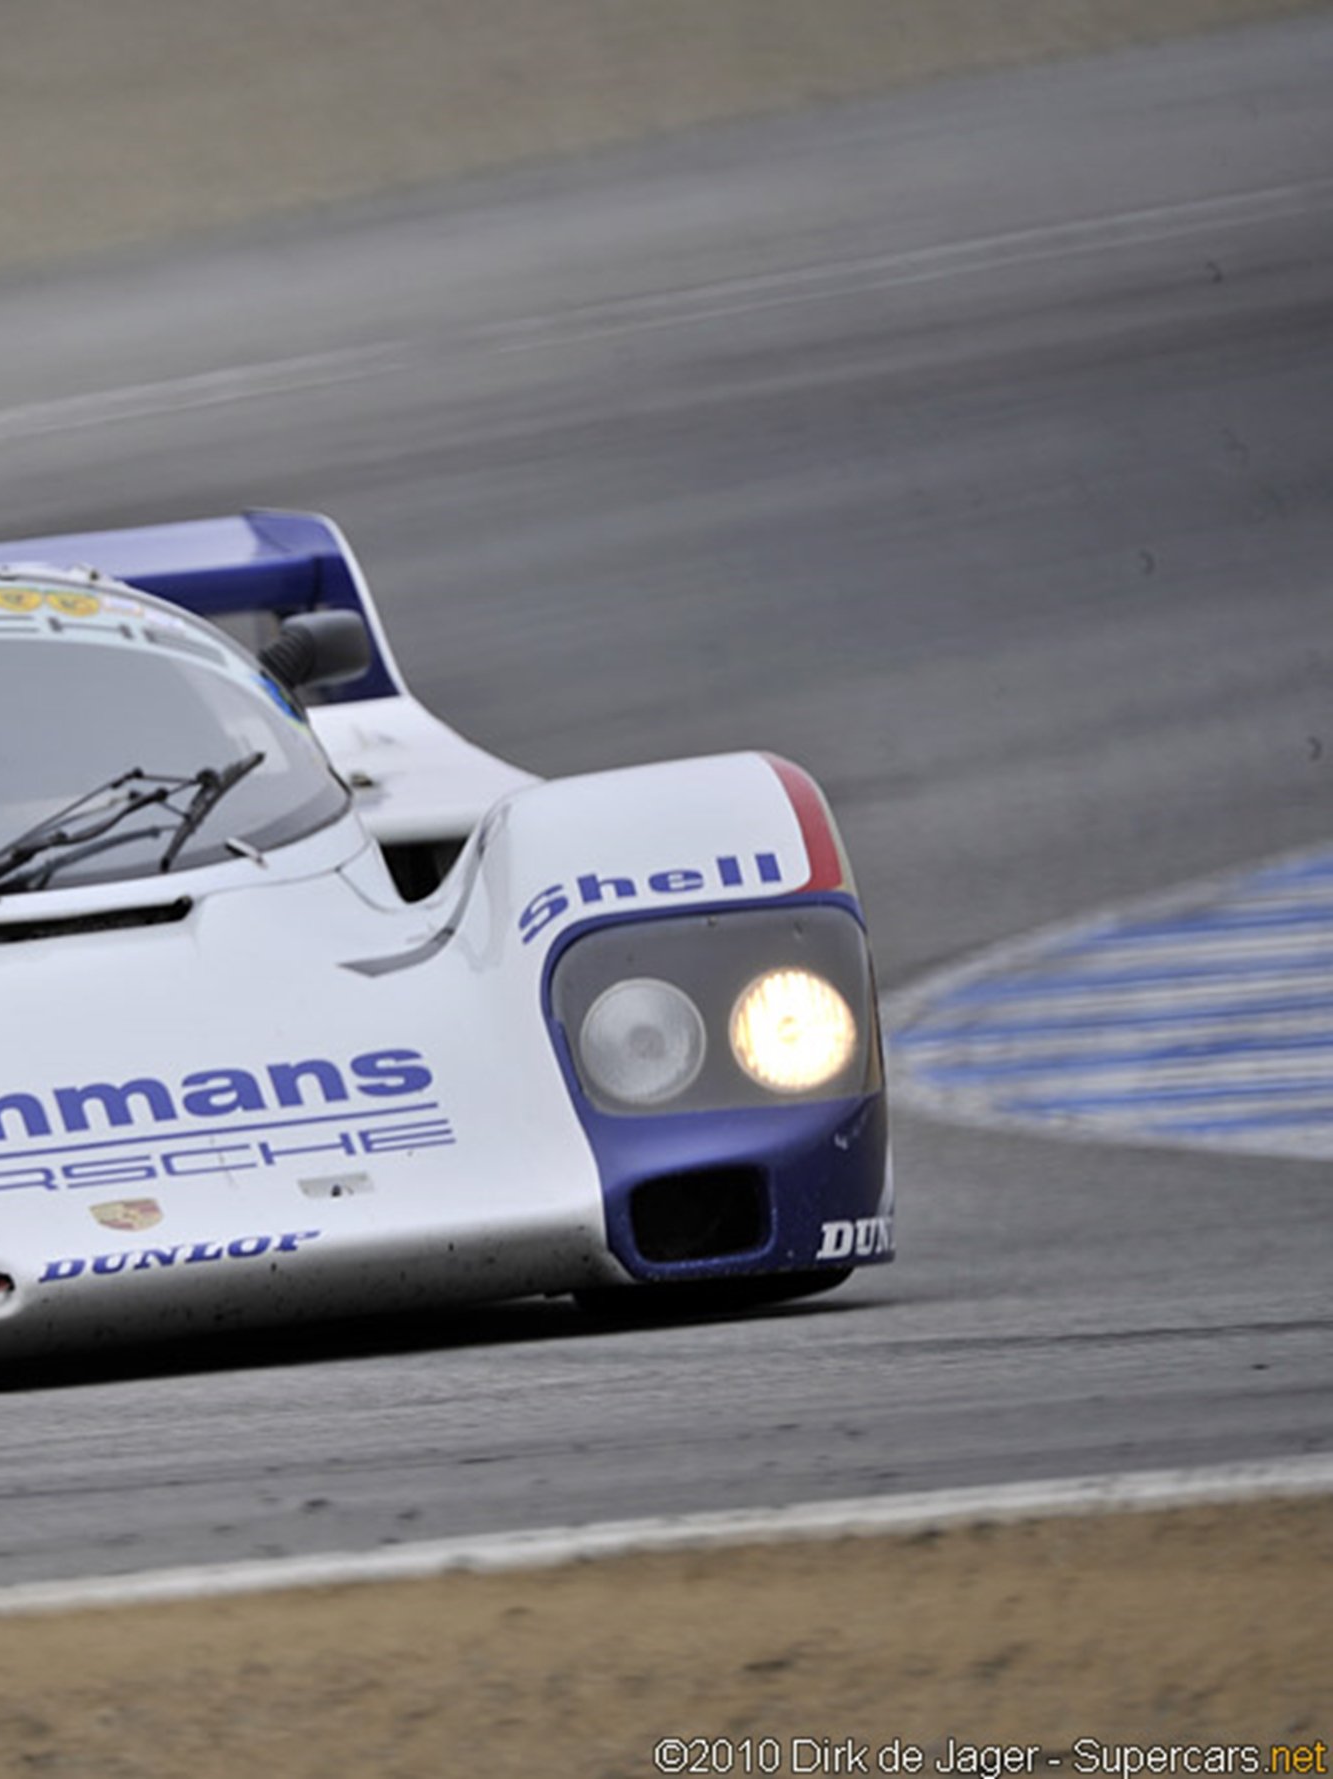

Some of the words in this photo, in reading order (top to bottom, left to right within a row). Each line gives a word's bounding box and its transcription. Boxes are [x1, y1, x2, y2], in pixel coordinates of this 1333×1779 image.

[519, 853, 782, 944] Shell
[38, 1230, 321, 1283] DUNLOP
[816, 1217, 891, 1259] DUN
